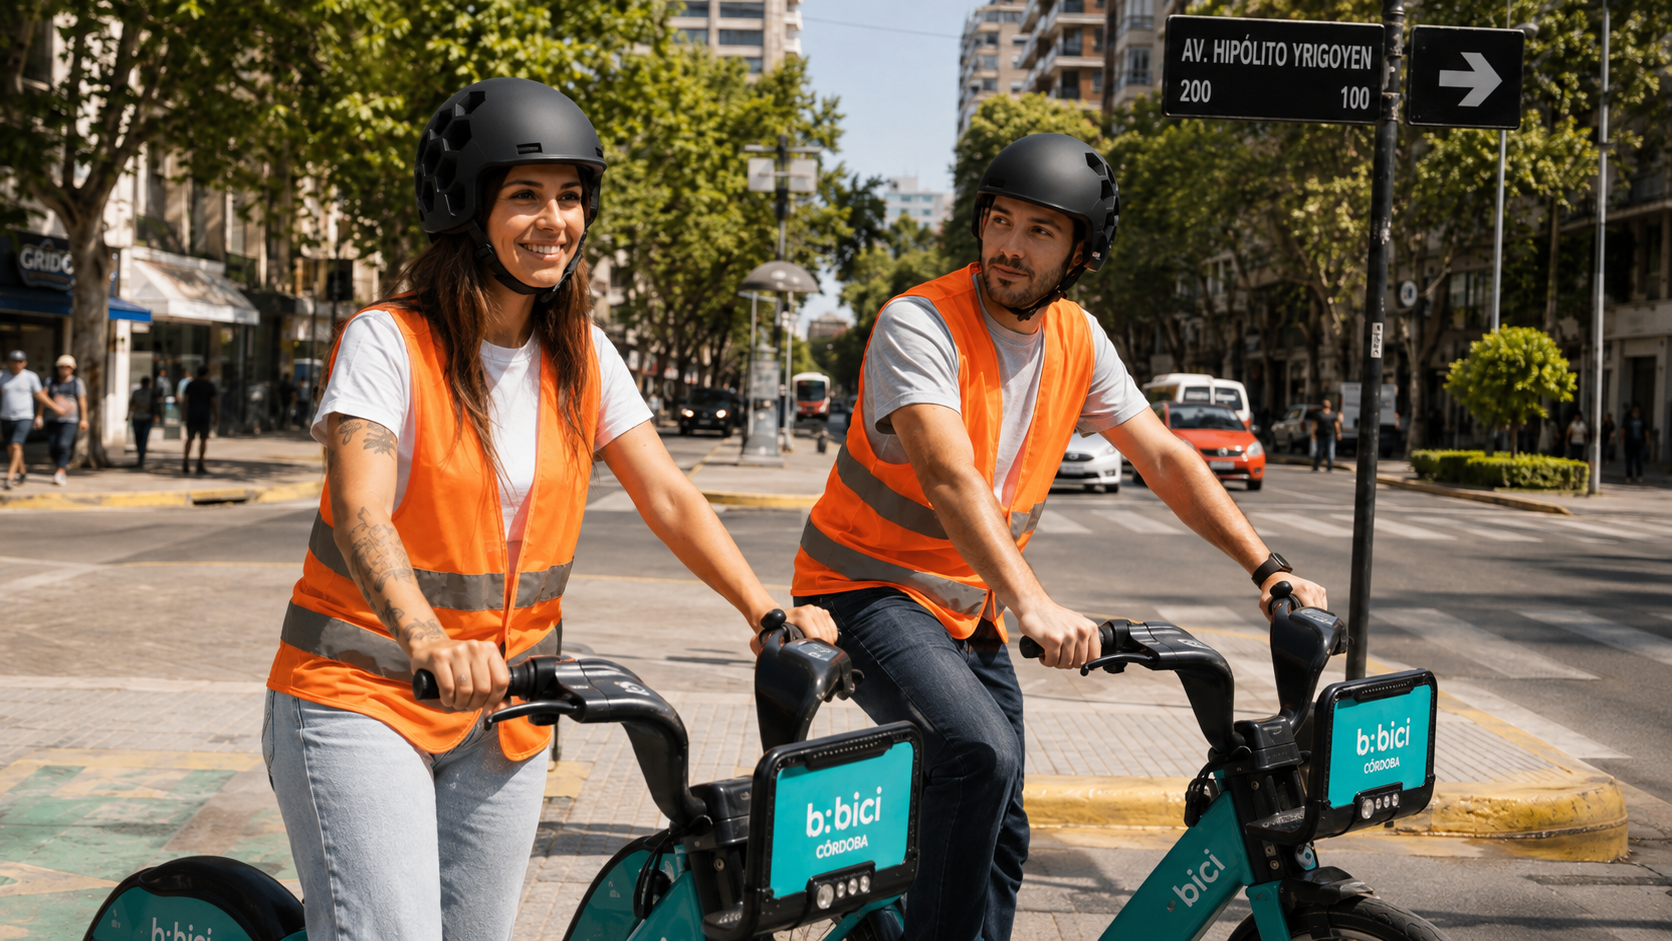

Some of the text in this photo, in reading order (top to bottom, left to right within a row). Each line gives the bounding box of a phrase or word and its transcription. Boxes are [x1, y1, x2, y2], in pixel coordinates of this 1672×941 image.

[1181, 34, 1373, 70] AV. HIPÓLITO YRIGOYEN
[1179, 79, 1212, 103] 200
[1340, 86, 1370, 110] 100
[1356, 717, 1411, 756] b:bici
[1363, 756, 1400, 774] CÓRDOBA
[806, 786, 882, 838] b:bici
[816, 834, 868, 859] CÓRDOBA
[1172, 848, 1226, 908] bici
[151, 917, 212, 941] b:bi
